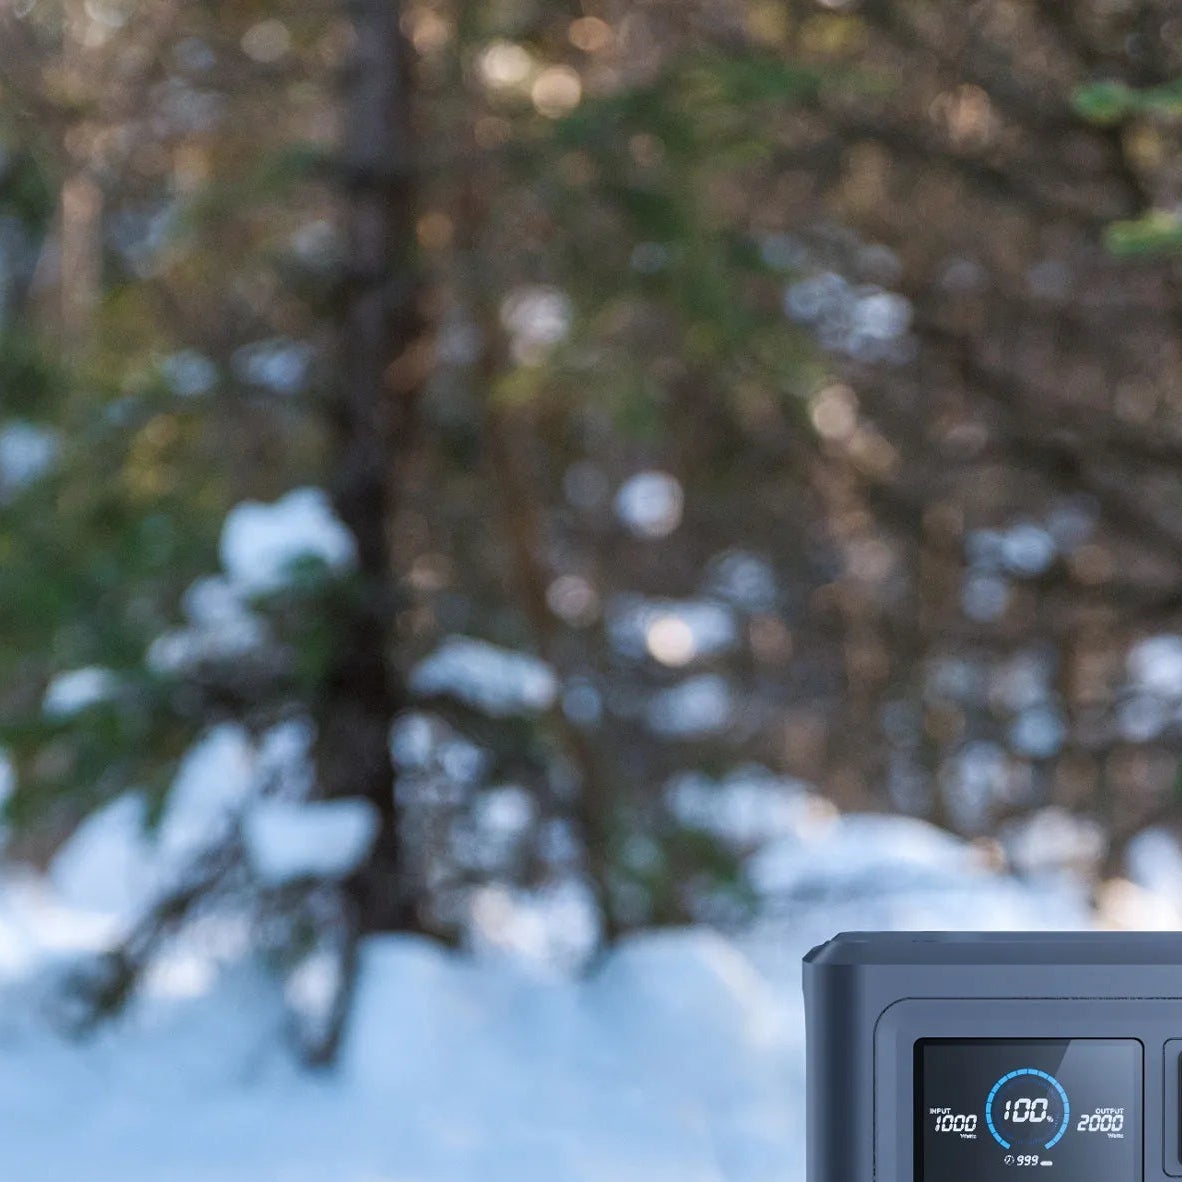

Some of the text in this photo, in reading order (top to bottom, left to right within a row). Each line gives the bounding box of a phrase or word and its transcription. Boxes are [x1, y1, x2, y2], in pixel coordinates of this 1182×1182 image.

[929, 1107, 952, 1115] INPUT
[1095, 1107, 1124, 1115] OUTPUT
[935, 1114, 978, 1132] 1000
[1077, 1114, 1124, 1132] 2000
[1016, 1154, 1040, 1167] 999
